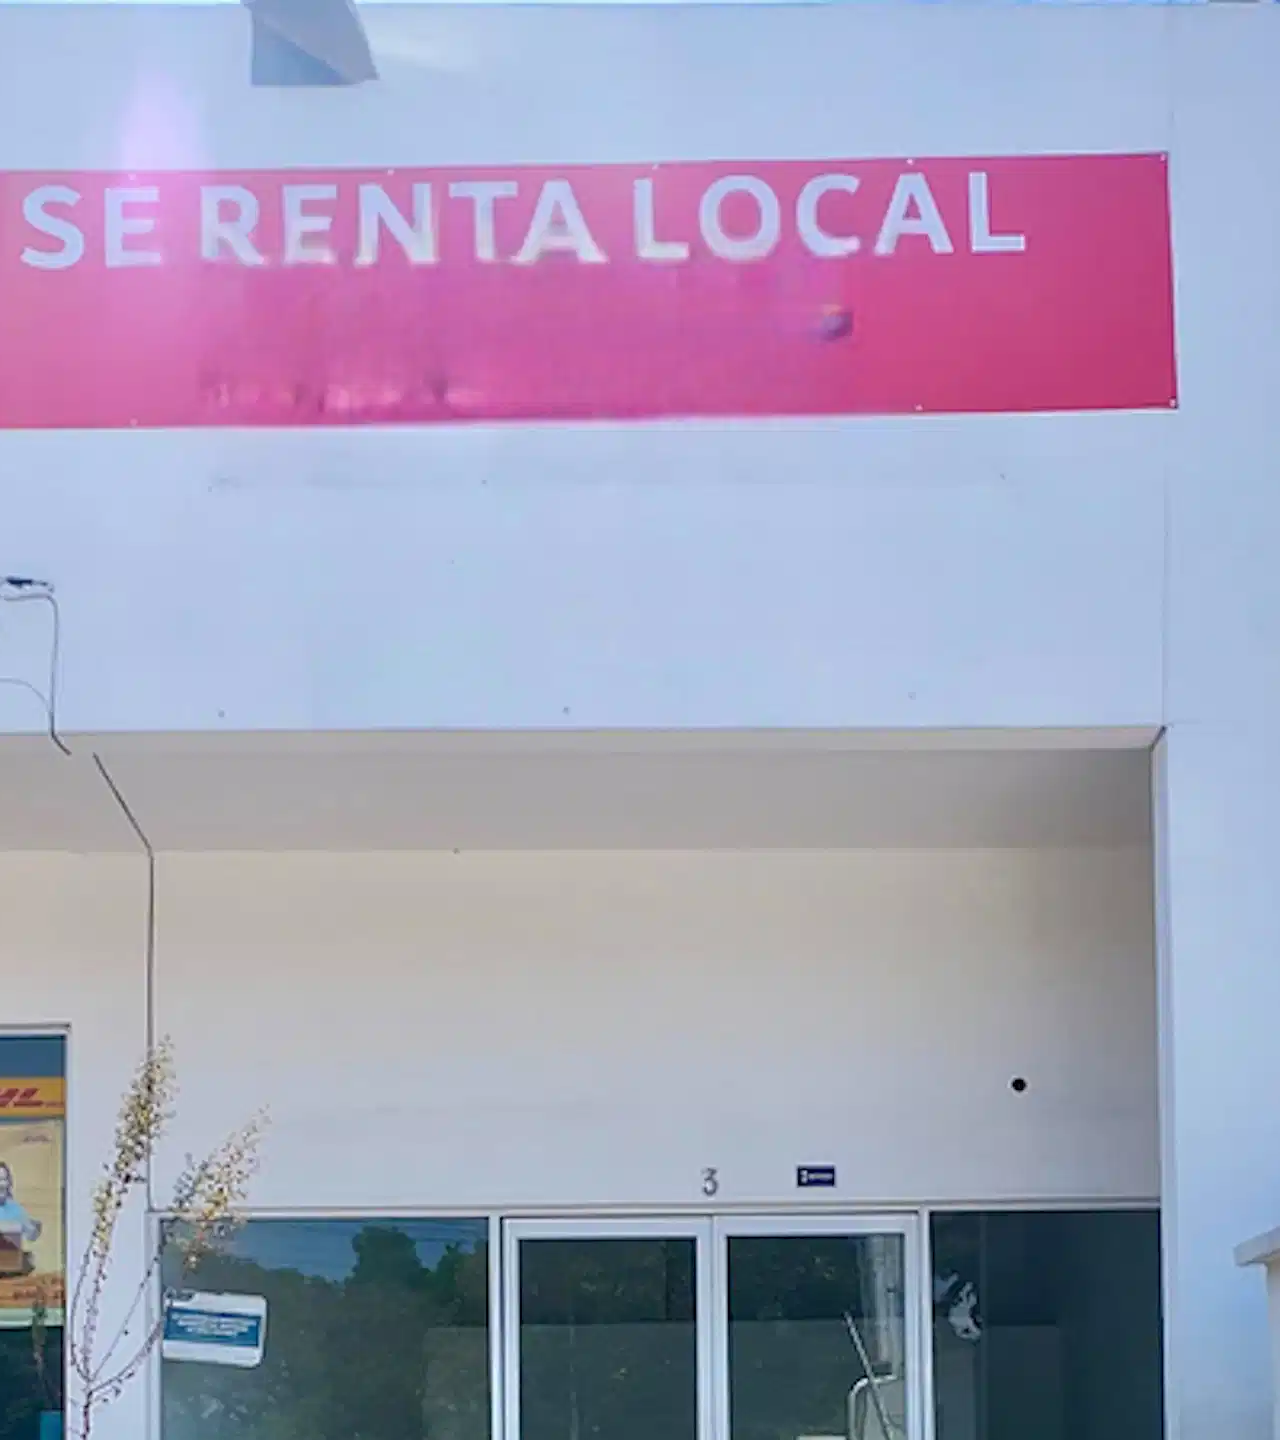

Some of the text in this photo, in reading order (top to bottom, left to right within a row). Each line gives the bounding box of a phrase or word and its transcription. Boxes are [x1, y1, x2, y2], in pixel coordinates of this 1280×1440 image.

[20, 171, 1026, 269] SE RENTA LOCAL
[701, 1167, 718, 1196] 3
